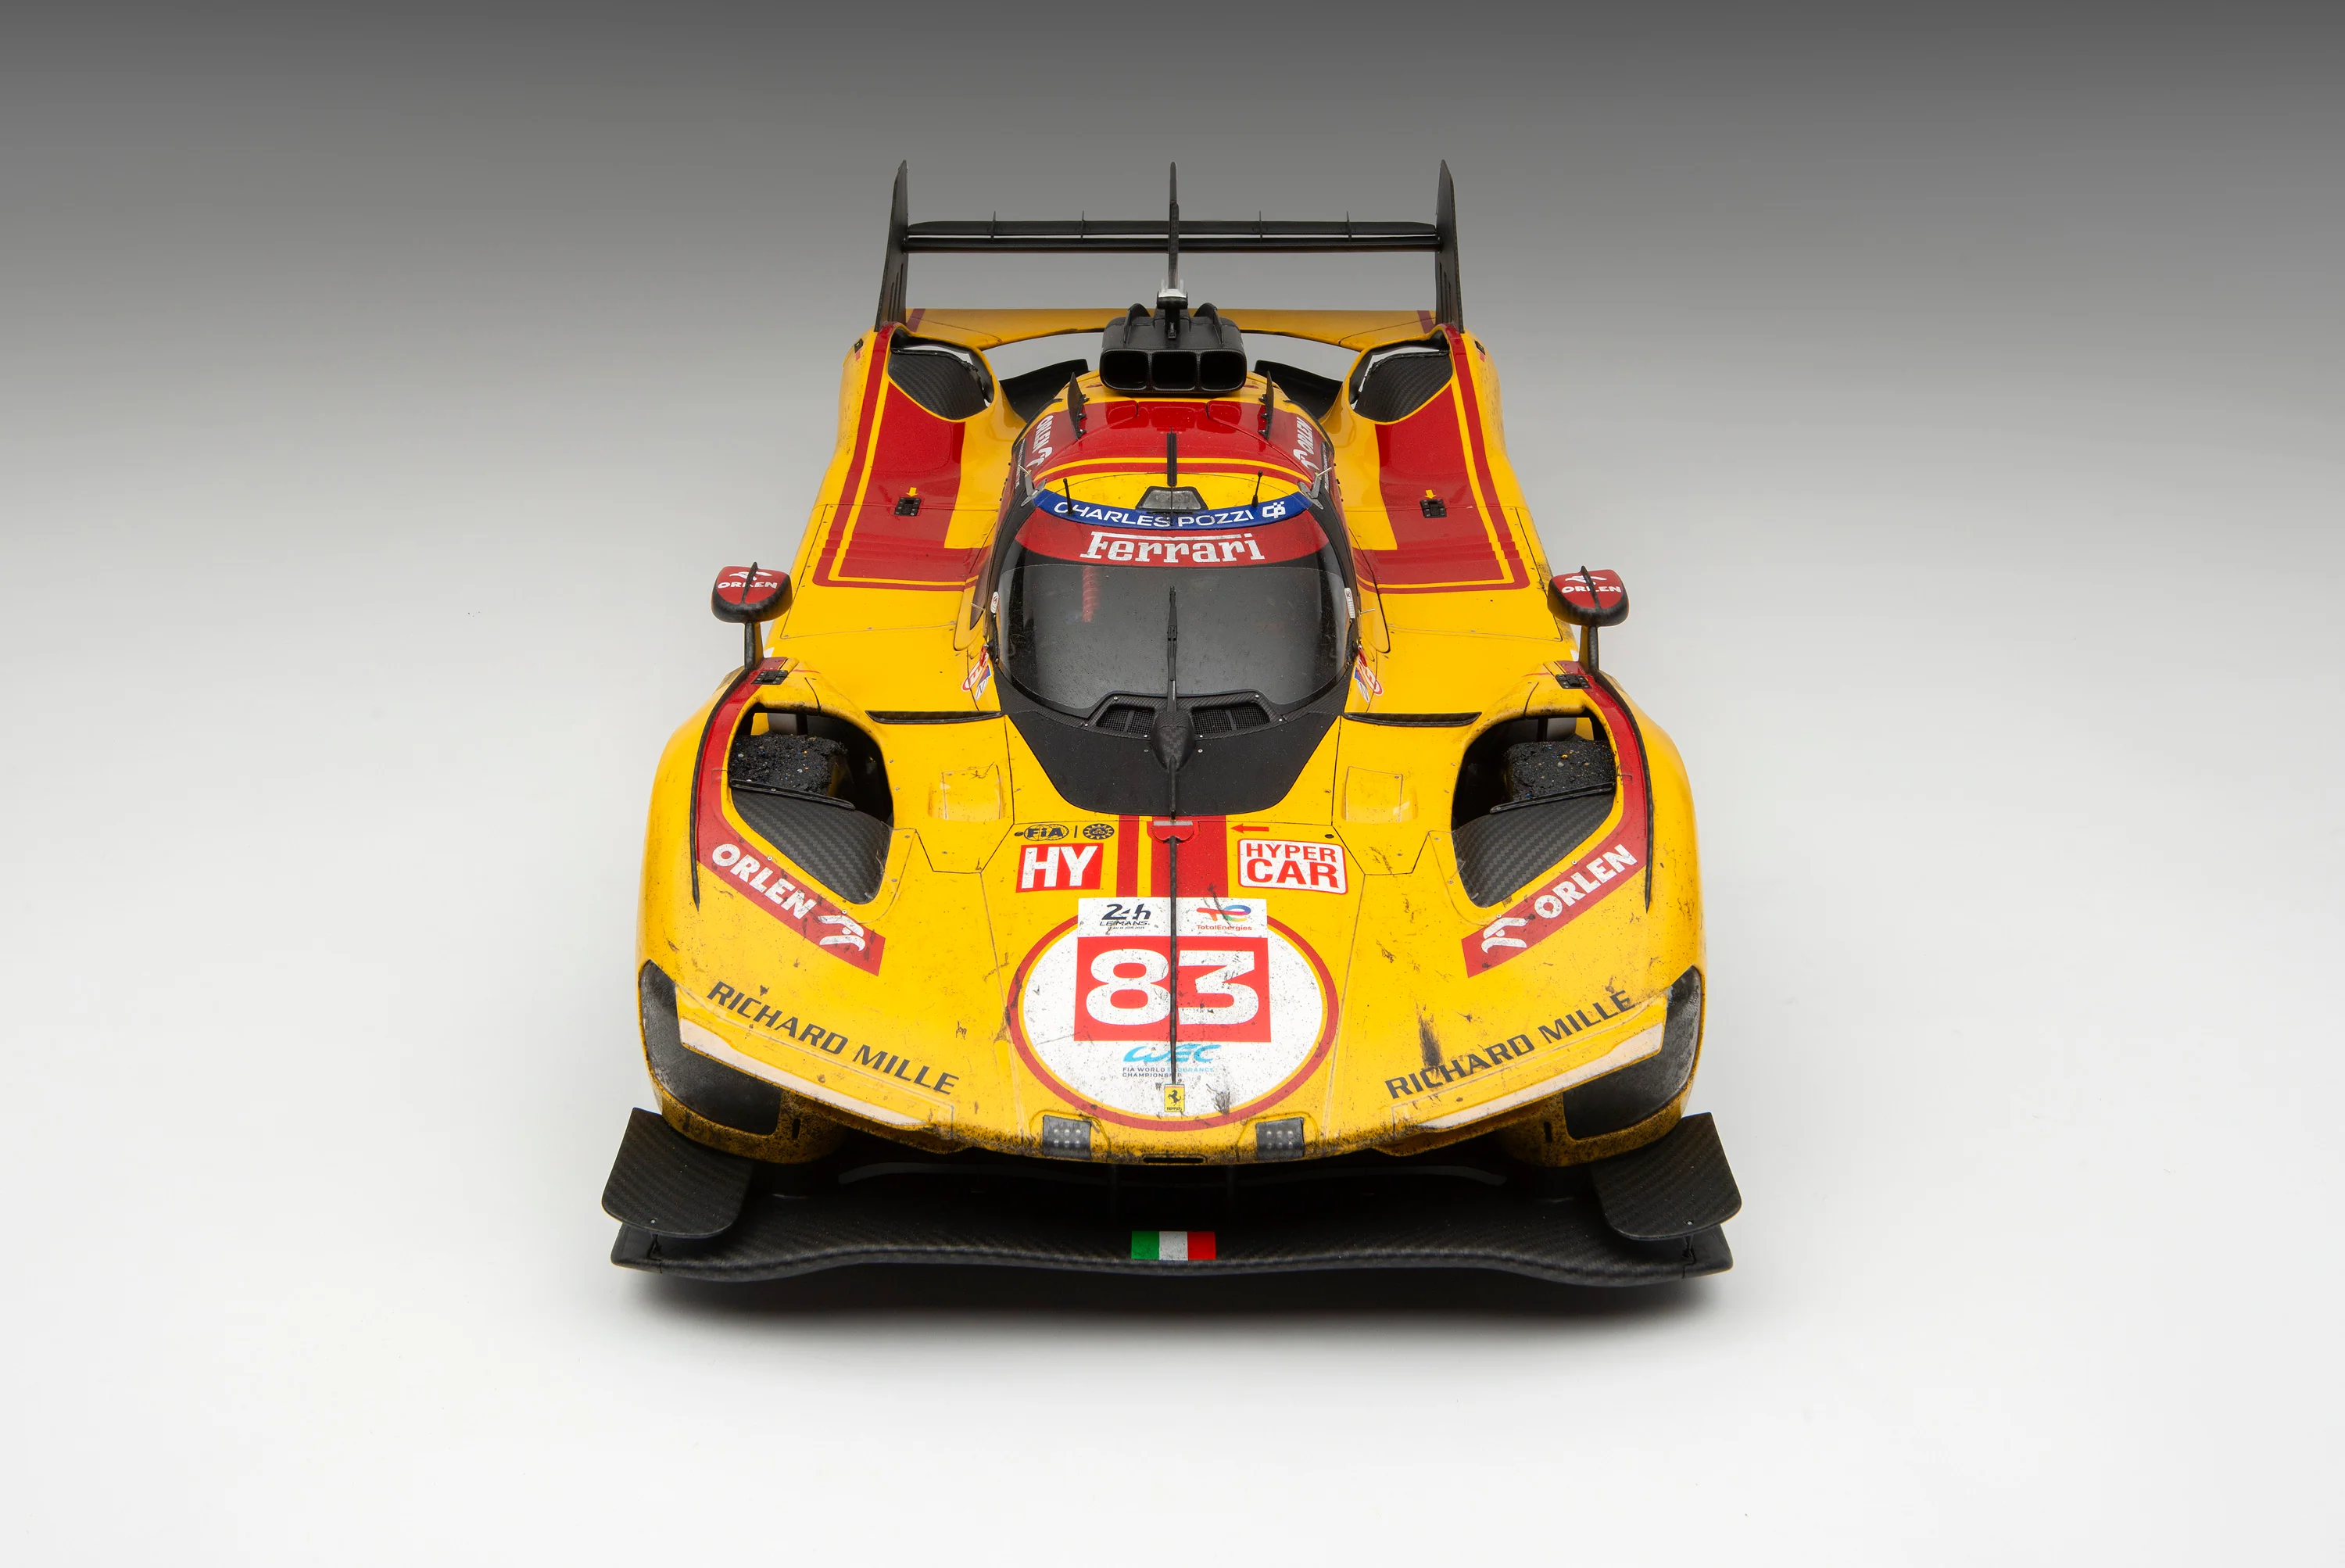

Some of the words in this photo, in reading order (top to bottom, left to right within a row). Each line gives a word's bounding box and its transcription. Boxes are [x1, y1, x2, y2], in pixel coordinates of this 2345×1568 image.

[1054, 502, 1171, 528] CHARLES
[1177, 510, 1254, 528] POZZI
[1079, 531, 1265, 564] Ferrari
[1021, 846, 1098, 890] HY
[1246, 843, 1337, 863] HYPER
[1247, 858, 1340, 889] CAR
[712, 843, 817, 922] ORLEN
[1534, 844, 1638, 918] ORLEN
[1086, 948, 1259, 1026] 83
[707, 980, 848, 1055] RICHARD
[853, 1044, 960, 1096] MILLE
[1122, 1043, 1222, 1062] WEC
[1384, 1033, 1535, 1100] RICHARD
[1538, 990, 1636, 1044] MILLE
